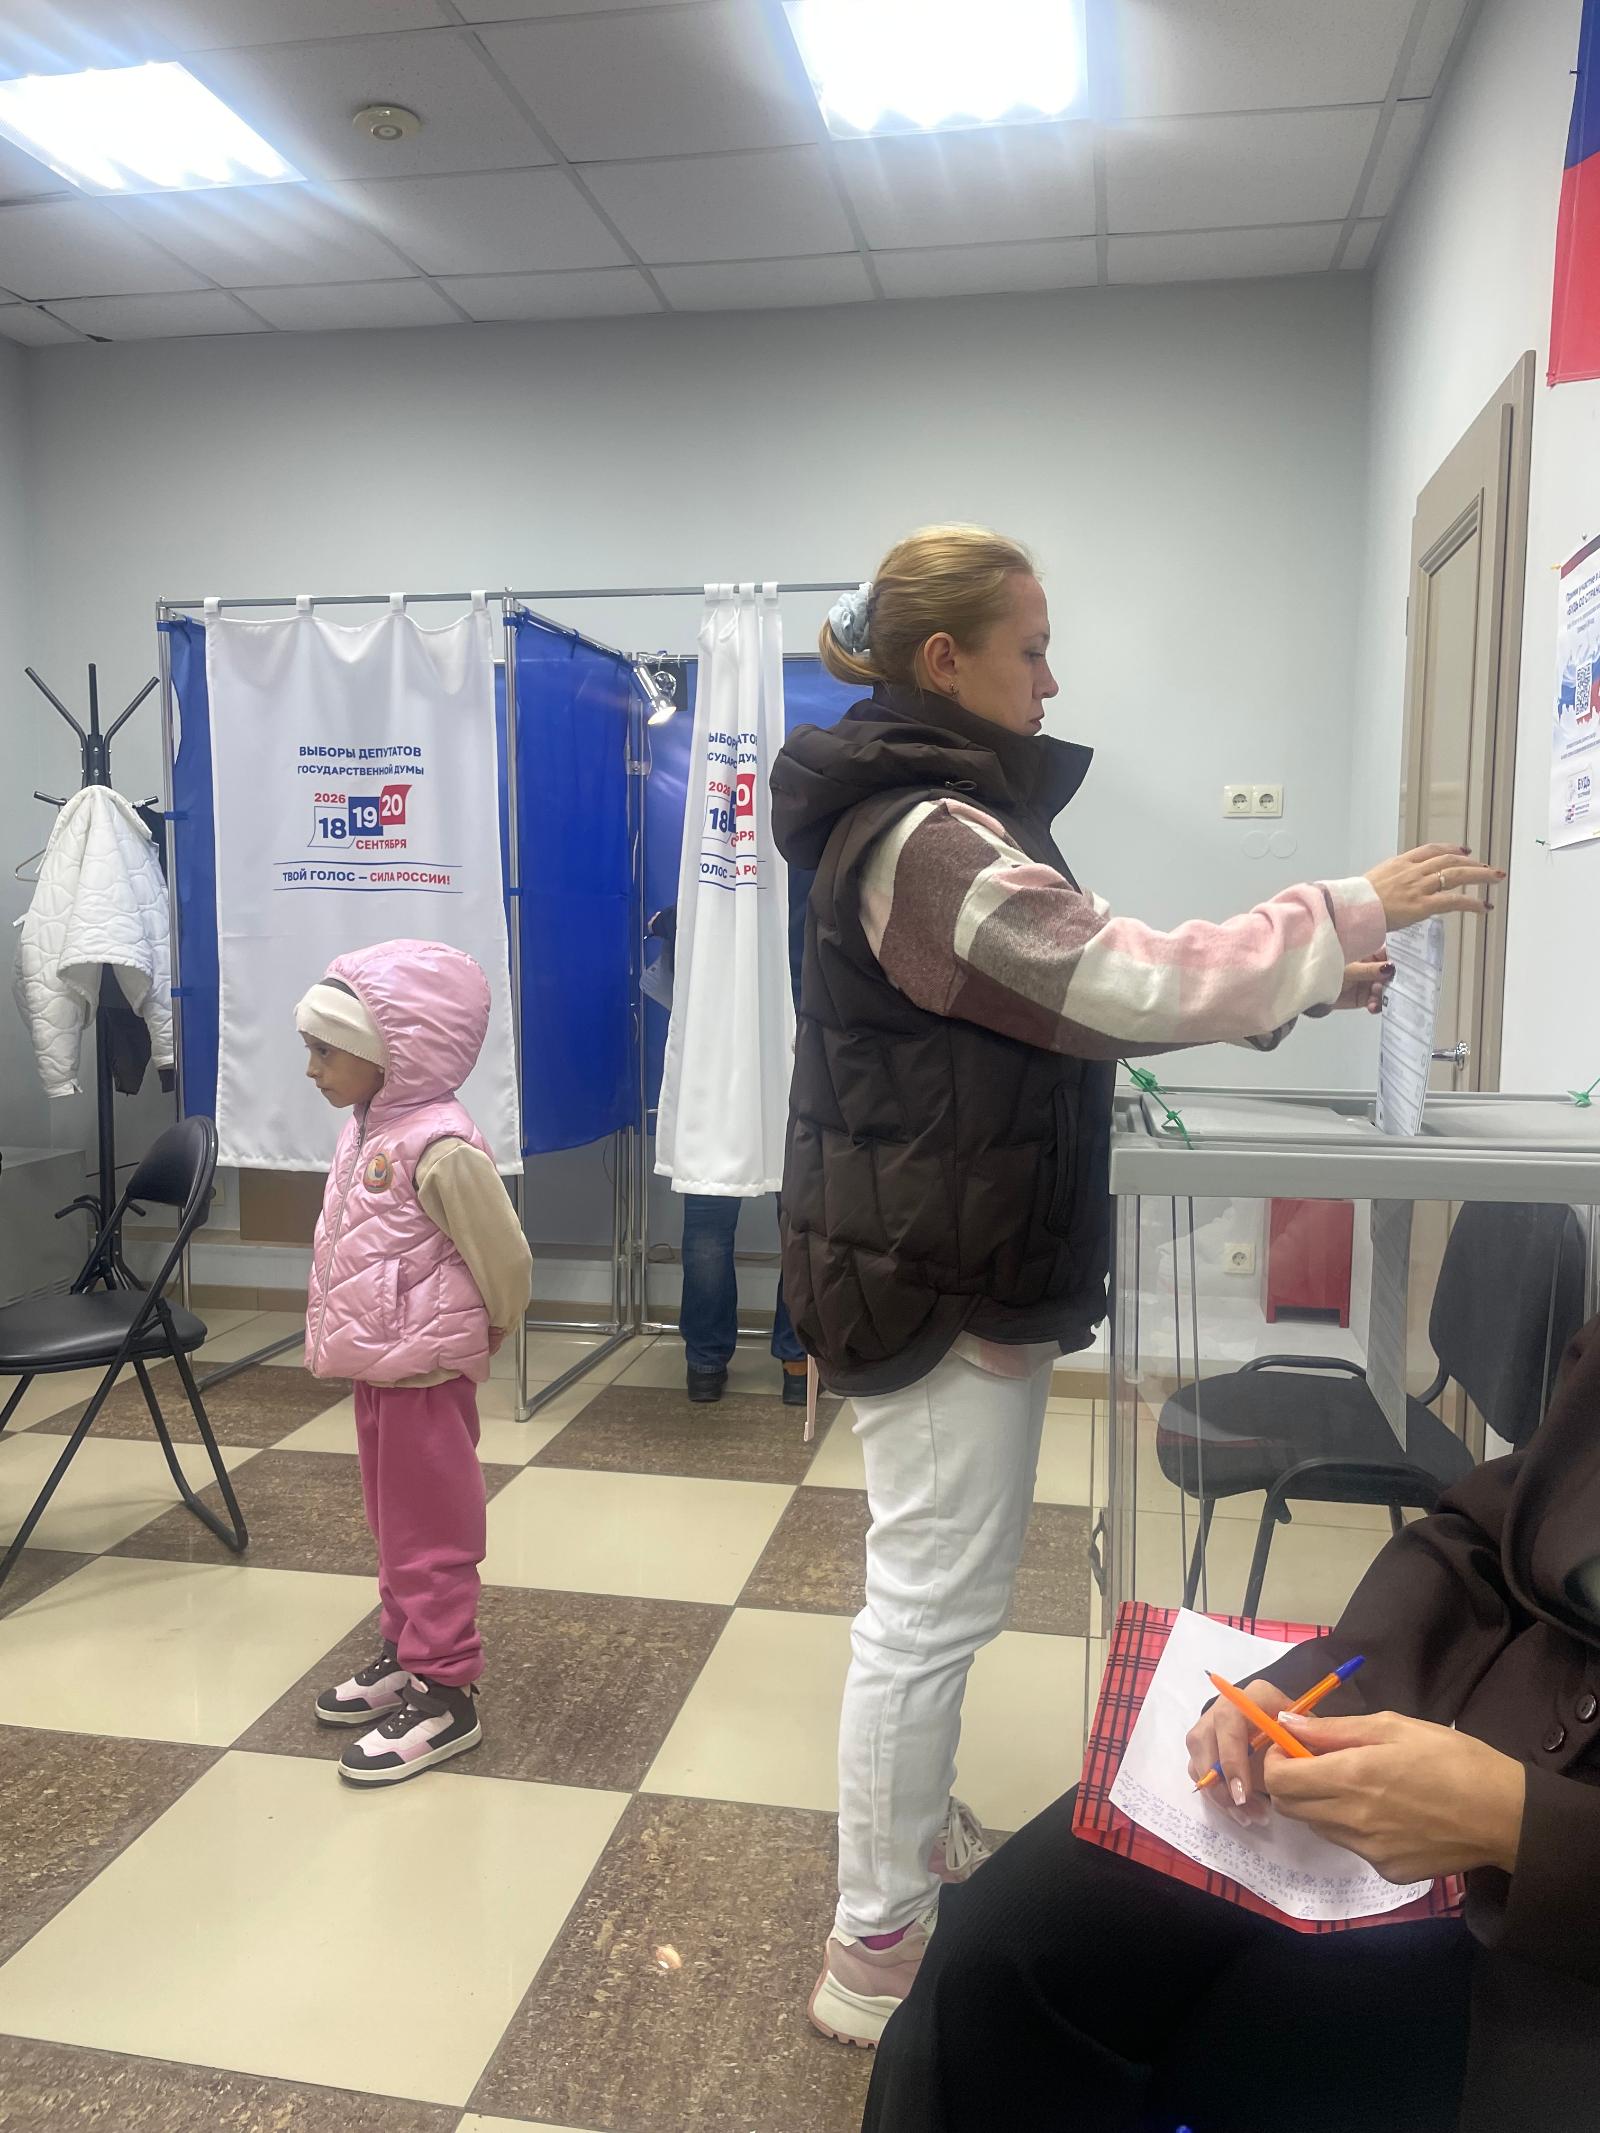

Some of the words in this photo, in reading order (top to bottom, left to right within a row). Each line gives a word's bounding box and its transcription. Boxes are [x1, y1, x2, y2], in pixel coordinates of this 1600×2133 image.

[299, 746, 356, 758] ВЫБОРЫ
[358, 746, 422, 760] ДЕПУТАТОВ
[297, 764, 393, 776] ГОСУДАРСТВЕННОЙ
[393, 765, 424, 775] ДУМЫ
[314, 792, 346, 804] 2026
[381, 794, 403, 817] 20
[352, 806, 378, 828] 19
[709, 807, 728, 833] 18
[318, 817, 347, 840] 18
[355, 839, 407, 850] СЕНТЯБРЯ
[282, 868, 307, 882] ТВОЙ
[310, 870, 356, 882] ГОЛОС
[370, 872, 395, 882] СИЛА
[397, 871, 451, 885] РОССИИ!
[700, 863, 728, 879] ОЛОС
